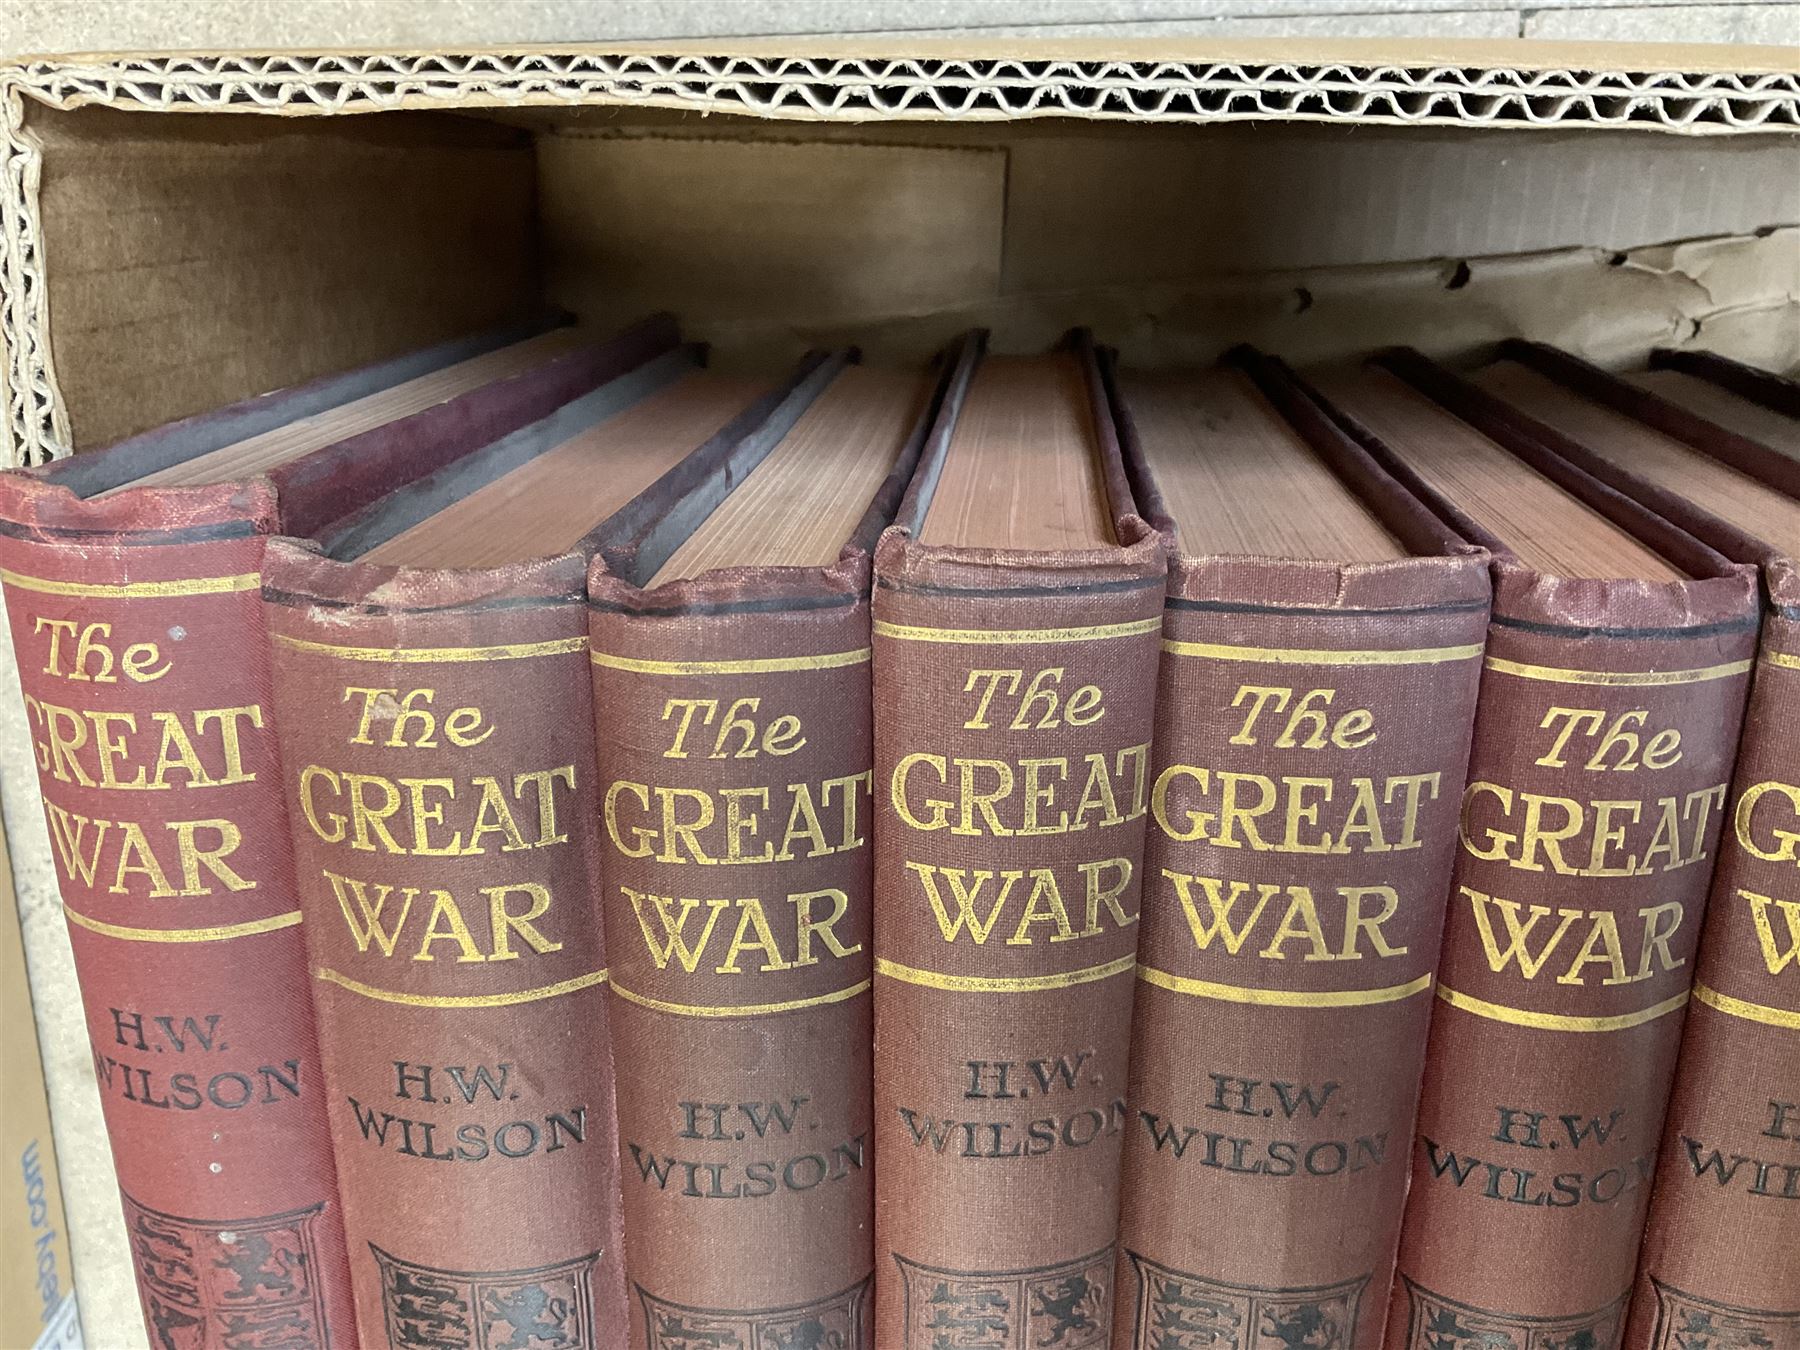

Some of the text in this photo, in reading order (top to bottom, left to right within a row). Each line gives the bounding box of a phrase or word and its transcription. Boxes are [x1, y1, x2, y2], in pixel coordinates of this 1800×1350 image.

[34, 617, 172, 683] The
[342, 686, 495, 749] The
[662, 698, 806, 760] The
[963, 667, 1105, 730] The
[1230, 685, 1377, 750] The
[1535, 706, 1683, 771] The
[300, 764, 575, 856] GREAT
[604, 768, 872, 866] GREAT
[891, 742, 1151, 838] GREAT
[1151, 764, 1440, 855] GREAT
[44, 796, 256, 898] WAR
[1459, 780, 1727, 878] GREAT
[323, 870, 563, 963] WAR
[620, 887, 862, 973] WAR
[905, 857, 1140, 946] WAR
[1162, 868, 1408, 962] WAR
[1459, 885, 1686, 987] WAR
[110, 1008, 228, 1053] H.W.
[395, 1060, 519, 1103] H.W.
[964, 1050, 1103, 1099] H.W.
[1205, 1072, 1347, 1119] H.W.
[348, 1097, 588, 1162] WILSON
[678, 1095, 820, 1141] H.W.
[1137, 1110, 1392, 1177] WILSON
[1491, 1105, 1628, 1150] H.W.
[628, 1132, 867, 1198] WILSON
